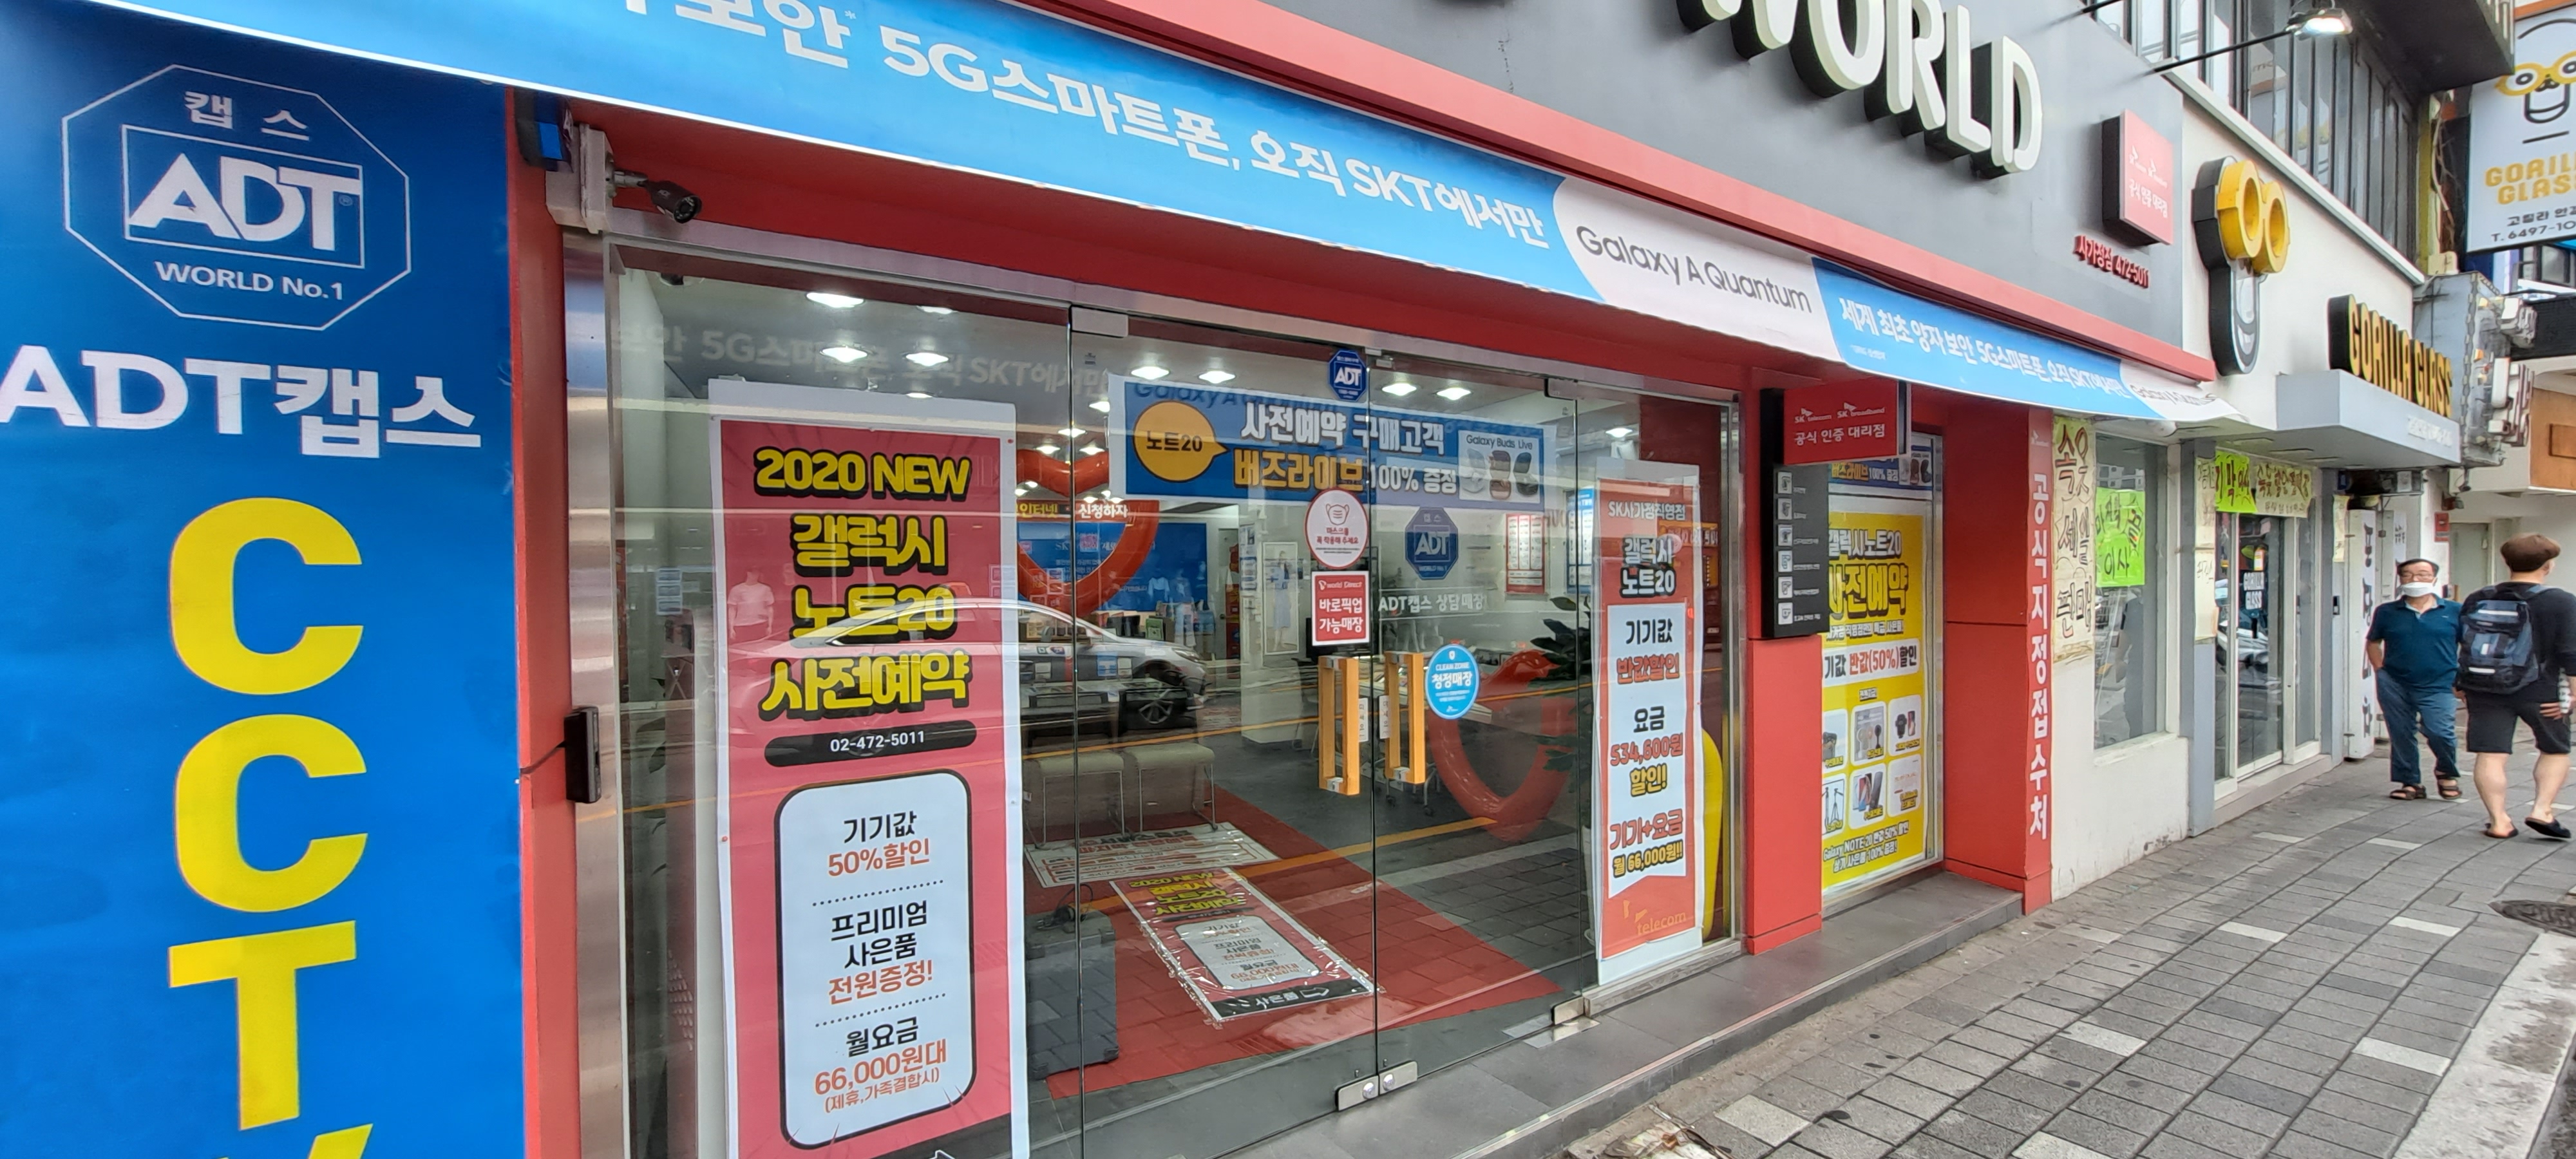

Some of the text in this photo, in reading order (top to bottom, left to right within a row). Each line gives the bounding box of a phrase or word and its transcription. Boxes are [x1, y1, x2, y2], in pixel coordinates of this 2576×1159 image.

[1680, 0, 2043, 174] ORLD
[880, 26, 1240, 171] 5G스마트폰,
[1251, 131, 1346, 196] 오직
[1347, 158, 1549, 249] SKT에서만
[2485, 152, 2576, 187] GORIL
[129, 153, 361, 250] ADT
[2497, 174, 2576, 205] GLAS
[2507, 211, 2549, 227] 고릴라
[1575, 226, 1812, 314] Galaxy A Quantum
[2073, 235, 2150, 289] 사가정점 472-5011
[155, 261, 344, 301] WORLD No.1
[1839, 297, 1880, 336] 세계
[1877, 309, 1914, 343] 최초
[1911, 320, 1946, 355] 양자
[1944, 330, 1977, 365] 보안
[2348, 294, 2453, 419] GORILLA GLASS
[1334, 367, 1361, 386] ADT
[0, 345, 481, 458] ADT캡스
[1146, 430, 1203, 452] 노트20
[1241, 402, 1444, 455] 사전예약 구매고객
[1466, 434, 1533, 450] Galaxy Buds Live
[1794, 424, 1886, 446] 공식 인증 대리점
[754, 447, 972, 501] 2020 NEW
[1233, 449, 1457, 495] 버즈라이브 100% 증정
[1016, 502, 1128, 519] 인터넷 신청하자
[791, 513, 949, 576] 갤럭시
[1415, 531, 1449, 555] ADT
[1624, 534, 1673, 567] 갤럭시
[1620, 567, 1677, 598] 노트20
[791, 584, 958, 645] 노트20
[1319, 598, 1363, 613] 바로픽업
[1378, 595, 1432, 613] ADT캡스
[1319, 617, 1363, 634] 가능매장
[1625, 618, 1673, 645] 기기값
[759, 650, 973, 720] 사전예약
[1432, 671, 1473, 690] 청정매장
[1616, 653, 1680, 684] 반값할인
[1633, 706, 1665, 733] 요금
[830, 731, 925, 752] 02-472-5011
[1610, 733, 1684, 766] 534,600원
[1629, 762, 1667, 797] 할인!
[168, 497, 374, 1159] CCT
[844, 811, 917, 844] 기기값
[1610, 808, 1683, 850] 기기+요금
[1844, 836, 1864, 853] NOTE
[828, 838, 931, 877] 50%할인
[1613, 839, 1683, 878] 월 66,000원!!
[831, 900, 928, 941] 프리미엄
[1636, 910, 1687, 936] telecom
[844, 932, 918, 969] 사은품
[828, 959, 934, 1004] 전원증정!
[846, 1016, 919, 1058] 월요금
[815, 1039, 949, 1095] 66,000원대
[825, 1069, 941, 1113] (제휴,가족결합시)
